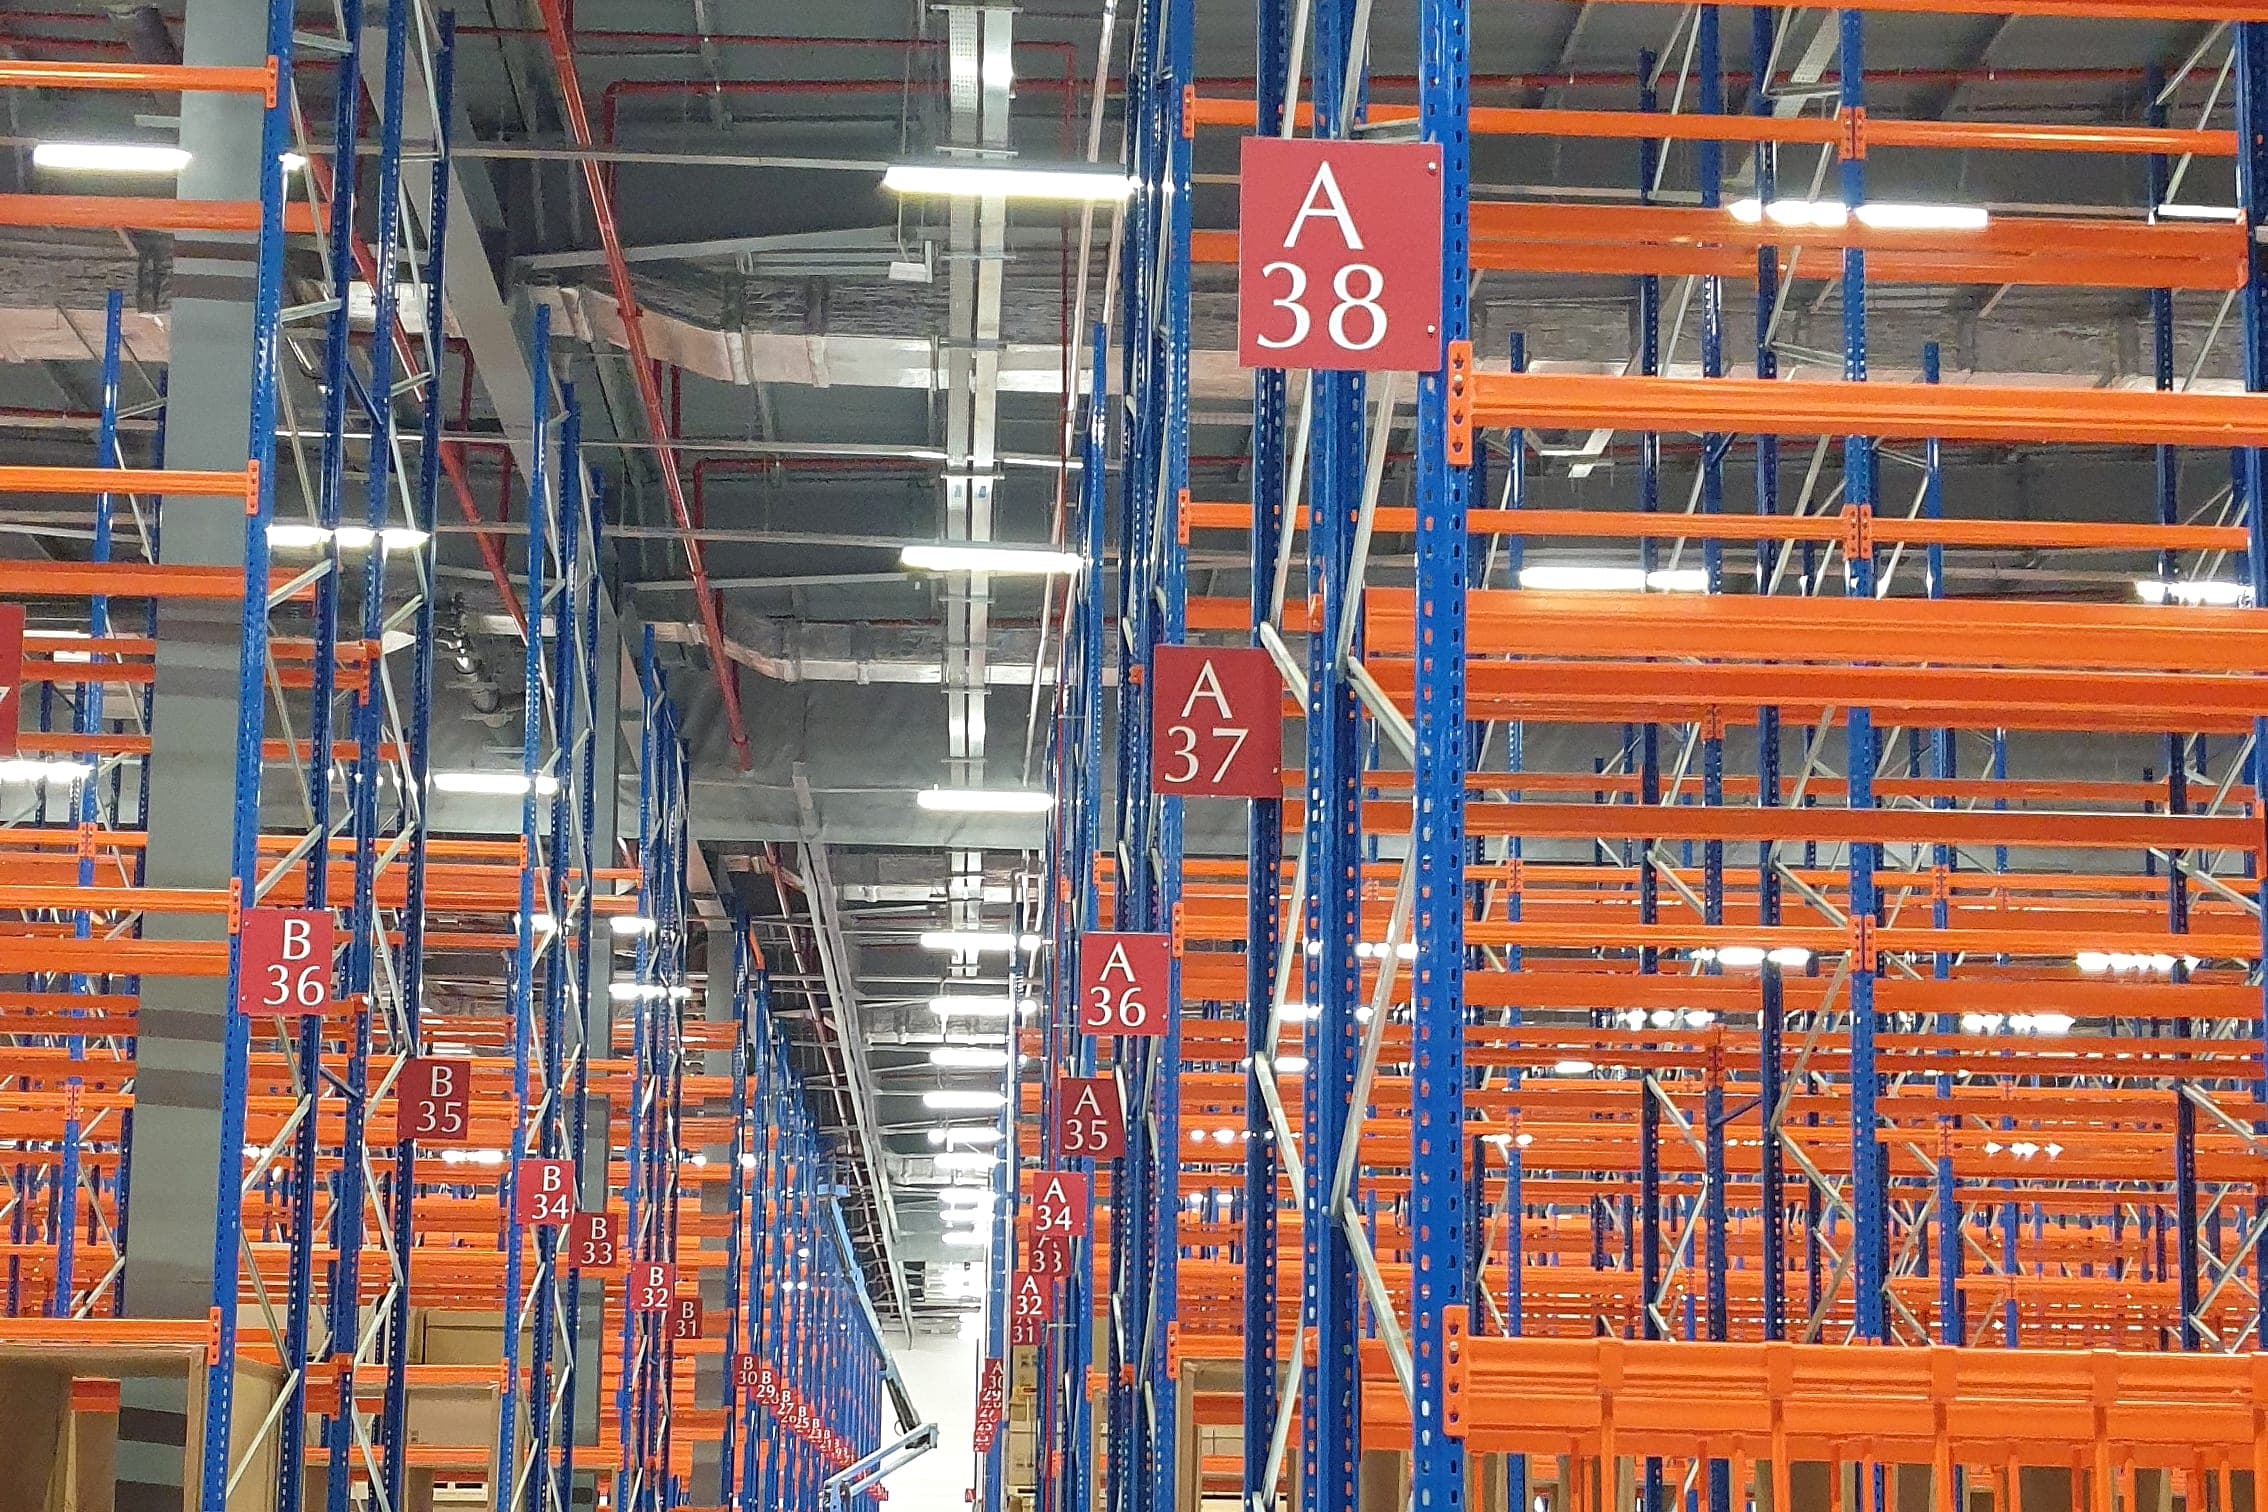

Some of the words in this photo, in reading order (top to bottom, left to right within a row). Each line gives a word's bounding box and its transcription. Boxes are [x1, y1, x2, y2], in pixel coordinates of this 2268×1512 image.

[1282, 160, 1364, 250] A
[1256, 261, 1388, 351] 38
[1181, 659, 1233, 719] A
[1164, 725, 1249, 783] 37
[282, 919, 311, 960] B
[1099, 941, 1136, 983] A
[263, 964, 326, 1006] 36
[1087, 986, 1146, 1027] 36
[430, 1065, 453, 1098] B
[1073, 1084, 1102, 1116] A
[416, 1100, 462, 1132] 35
[1064, 1119, 1108, 1151] 35
[543, 1165, 561, 1192] B
[1043, 1177, 1067, 1204] A
[531, 1193, 569, 1220] 34
[1035, 1205, 1073, 1231] 34
[591, 1217, 607, 1240] B
[581, 1241, 613, 1264] 33
[1031, 1249, 1063, 1273] 33
[649, 1266, 664, 1287] B
[1020, 1275, 1039, 1295] A
[640, 1287, 669, 1308] 32
[682, 1301, 695, 1319] B
[1015, 1295, 1043, 1315] 32
[674, 1319, 697, 1337] 31
[1012, 1325, 1033, 1343] 31
[743, 1356, 754, 1370] B
[737, 1370, 758, 1385] 30
[761, 1370, 772, 1384] B
[756, 1384, 776, 1398] 29
[782, 1390, 791, 1403] B
[777, 1402, 795, 1415] 27
